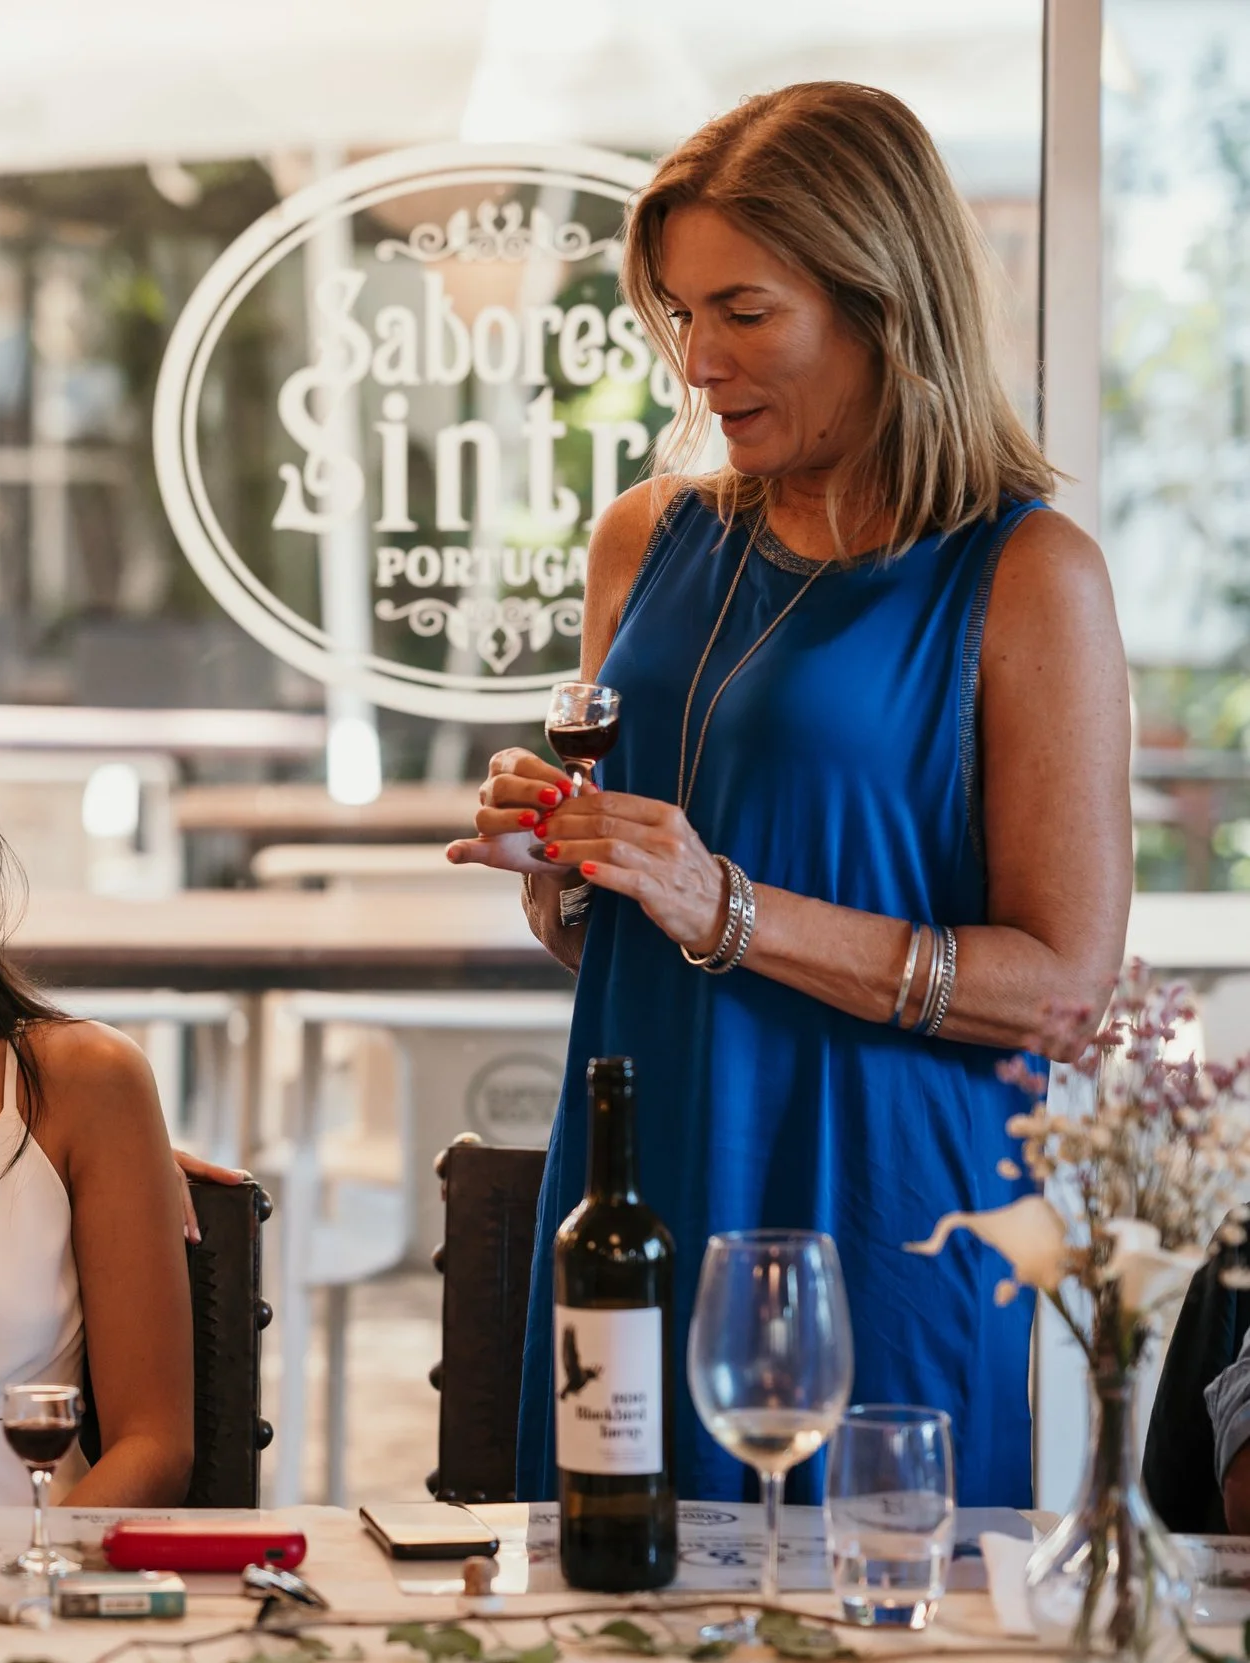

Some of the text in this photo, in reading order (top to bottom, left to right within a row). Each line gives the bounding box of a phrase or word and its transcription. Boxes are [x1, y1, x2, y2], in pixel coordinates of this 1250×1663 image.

[312, 268, 649, 388] Sabores
[271, 364, 653, 534] Sintr
[375, 546, 586, 597] PORTUGA
